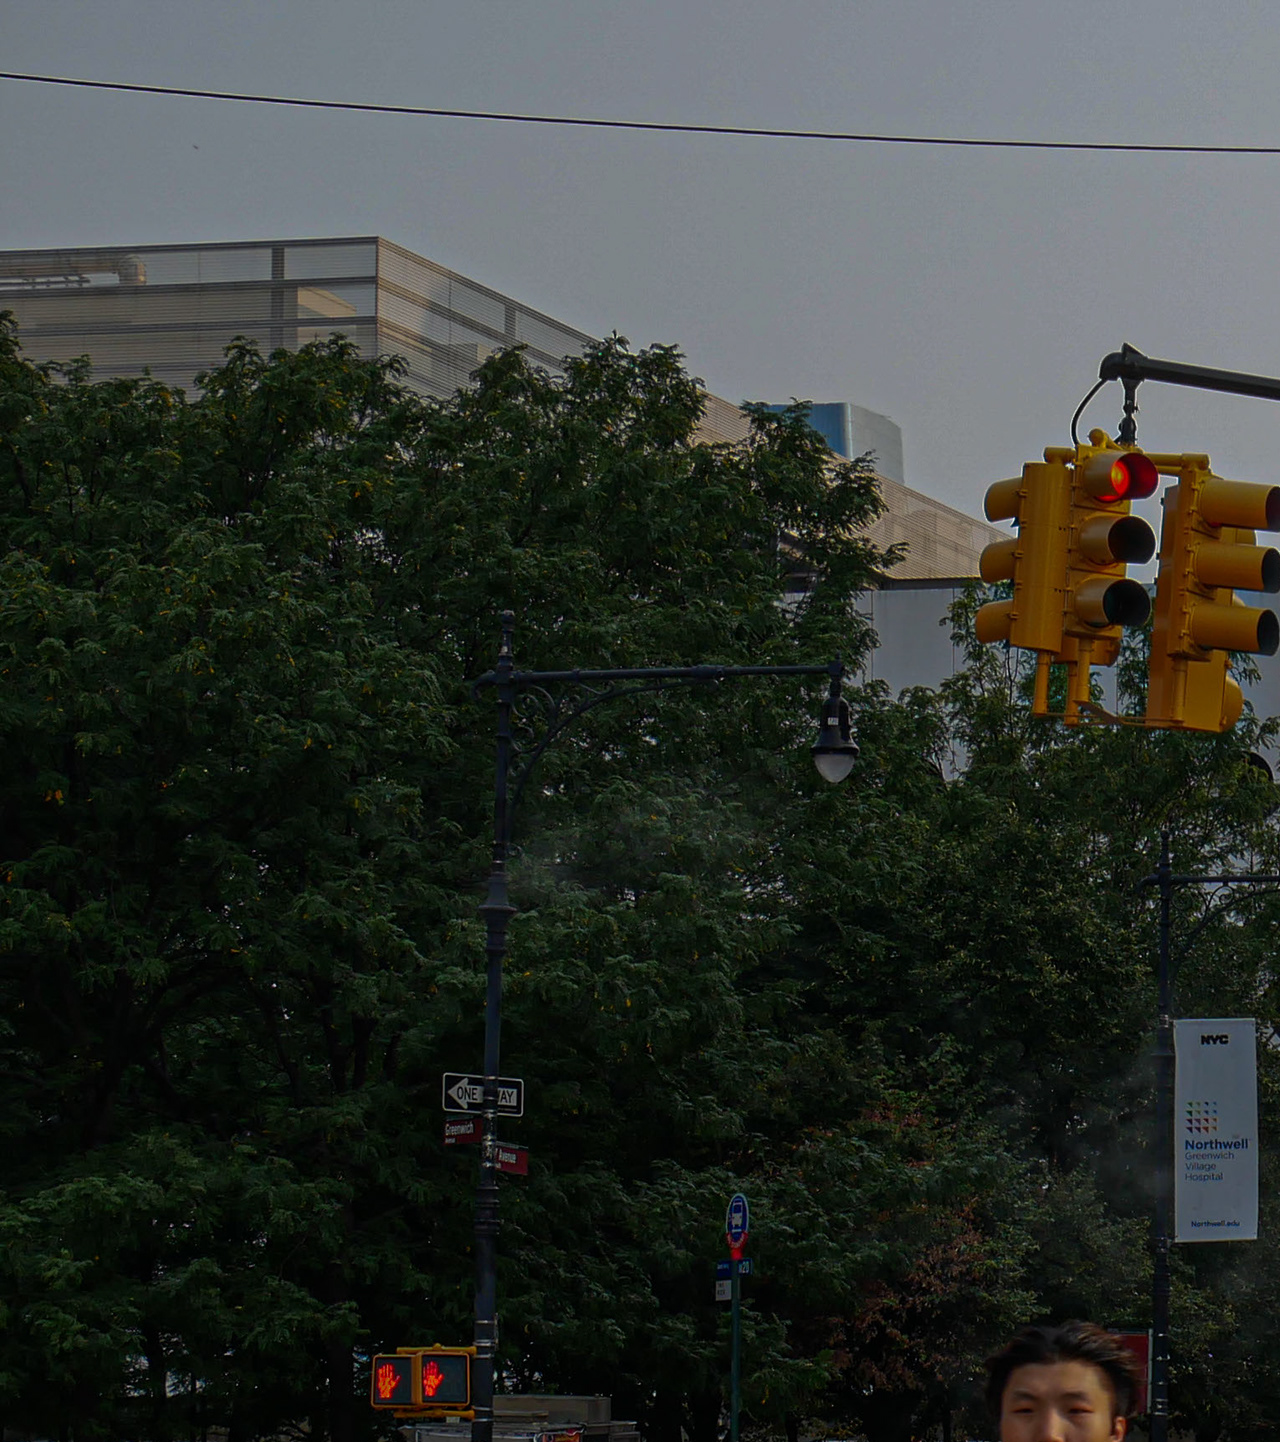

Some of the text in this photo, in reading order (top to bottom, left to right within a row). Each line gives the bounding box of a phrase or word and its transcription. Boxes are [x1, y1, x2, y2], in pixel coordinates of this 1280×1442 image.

[1201, 1034, 1229, 1045] NYC
[457, 1086, 478, 1101] ONE
[445, 1121, 475, 1137] Greenwich
[1185, 1138, 1249, 1151] Northwell
[1185, 1151, 1235, 1160] Greenwich
[1185, 1162, 1217, 1172] Village
[1185, 1172, 1224, 1182] Hospital
[1191, 1219, 1241, 1229] Northwell.edu
